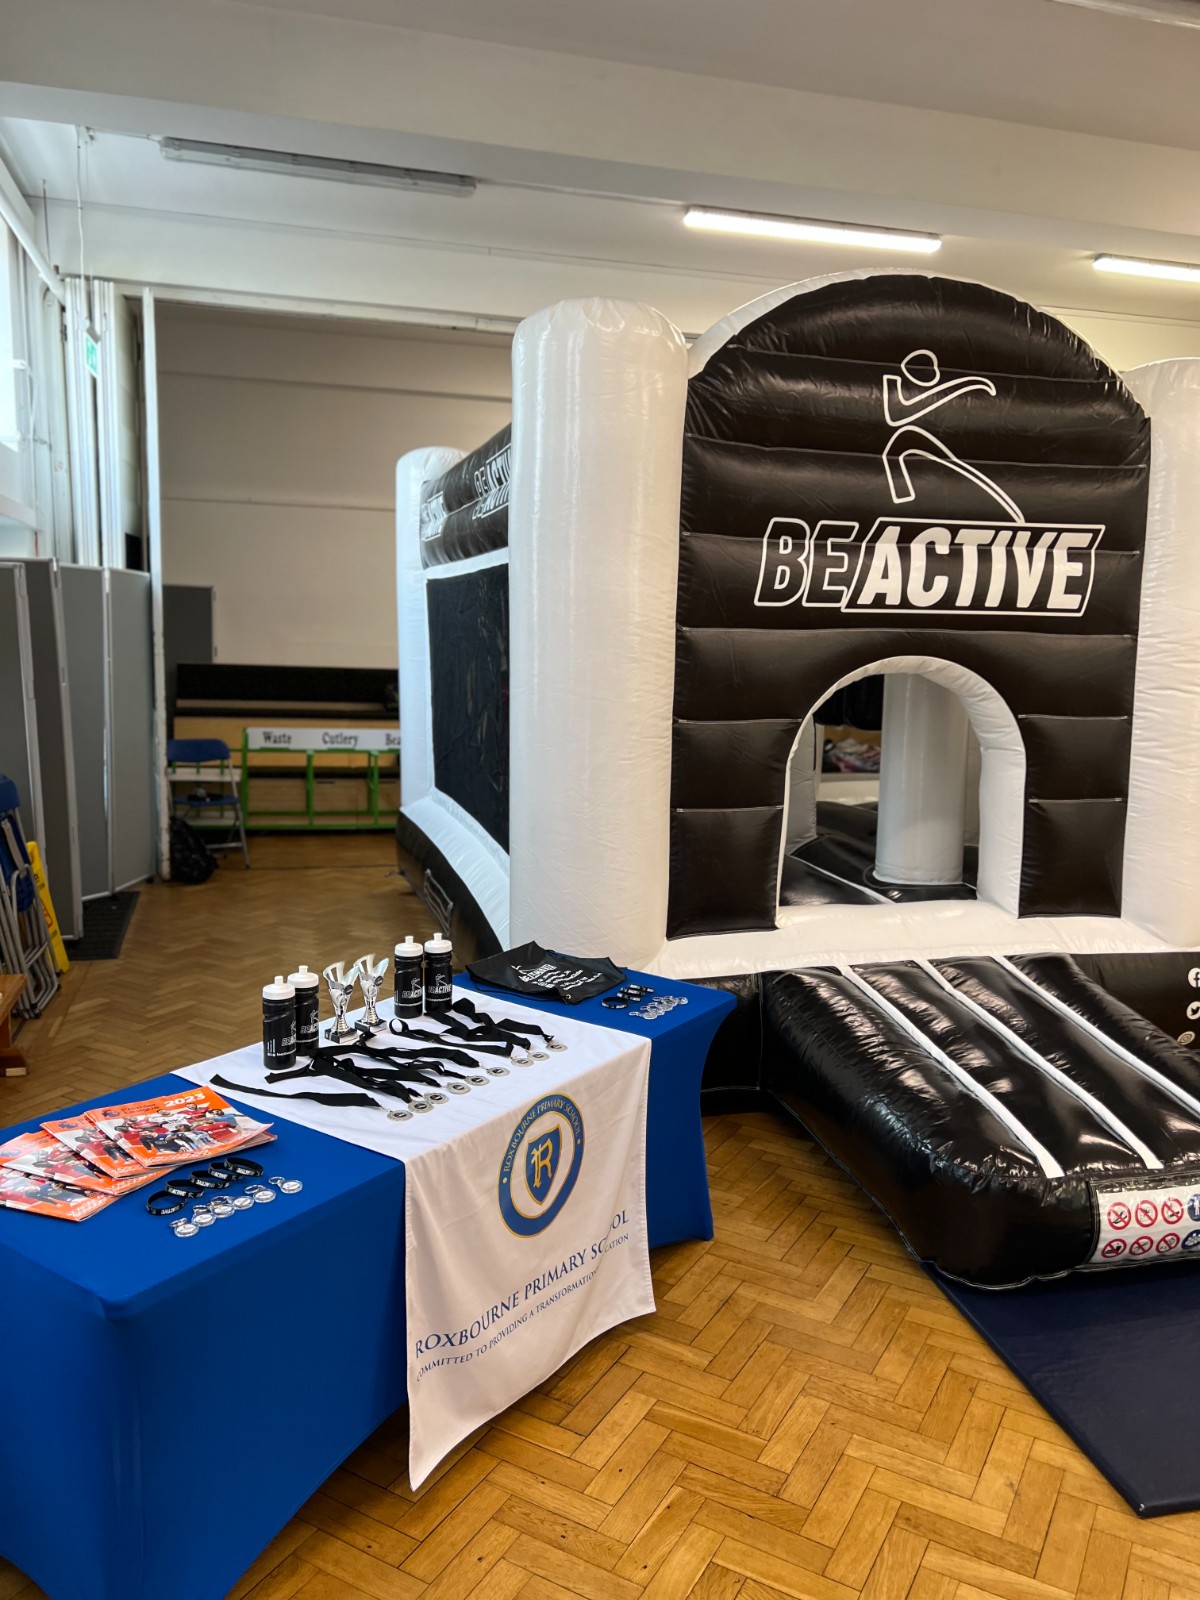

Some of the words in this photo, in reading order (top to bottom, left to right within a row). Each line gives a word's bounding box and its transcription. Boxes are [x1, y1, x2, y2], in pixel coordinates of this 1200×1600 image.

[262, 731, 292, 745] Waste
[322, 732, 359, 748] Cutlery
[164, 1092, 206, 1108] 2023
[503, 1110, 537, 1172] ROXBOURNE
[537, 1098, 565, 1114] PRIMARY
[564, 1104, 581, 1137] SCHOOL
[531, 1137, 553, 1188] R
[415, 1290, 519, 1359] ROXBOURNE
[524, 1248, 587, 1300] PRIMARY
[591, 1209, 629, 1260] SCOL
[416, 1352, 473, 1382] COMMITTED
[476, 1344, 488, 1357] TO
[489, 1312, 528, 1349] PROVIDING
[529, 1310, 535, 1318] A
